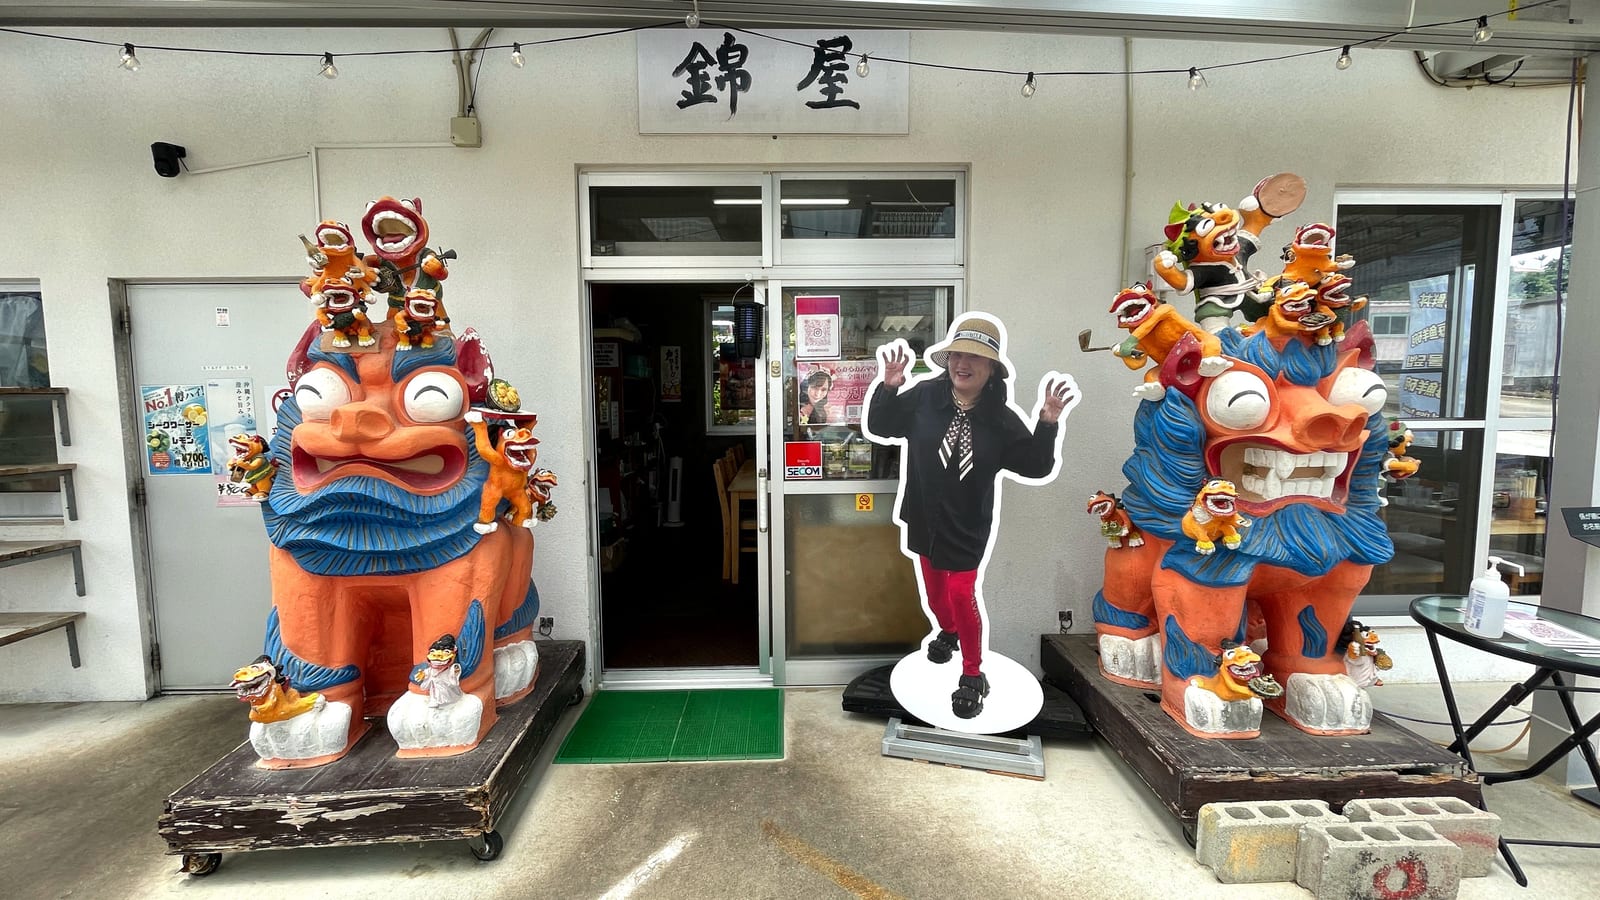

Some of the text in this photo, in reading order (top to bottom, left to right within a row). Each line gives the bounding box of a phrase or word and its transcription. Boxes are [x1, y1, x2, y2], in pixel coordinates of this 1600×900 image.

[672, 32, 860, 120] 錦屋
[145, 388, 173, 413] No.1
[148, 421, 200, 429] シークワーサー
[787, 467, 820, 475] SECOM
